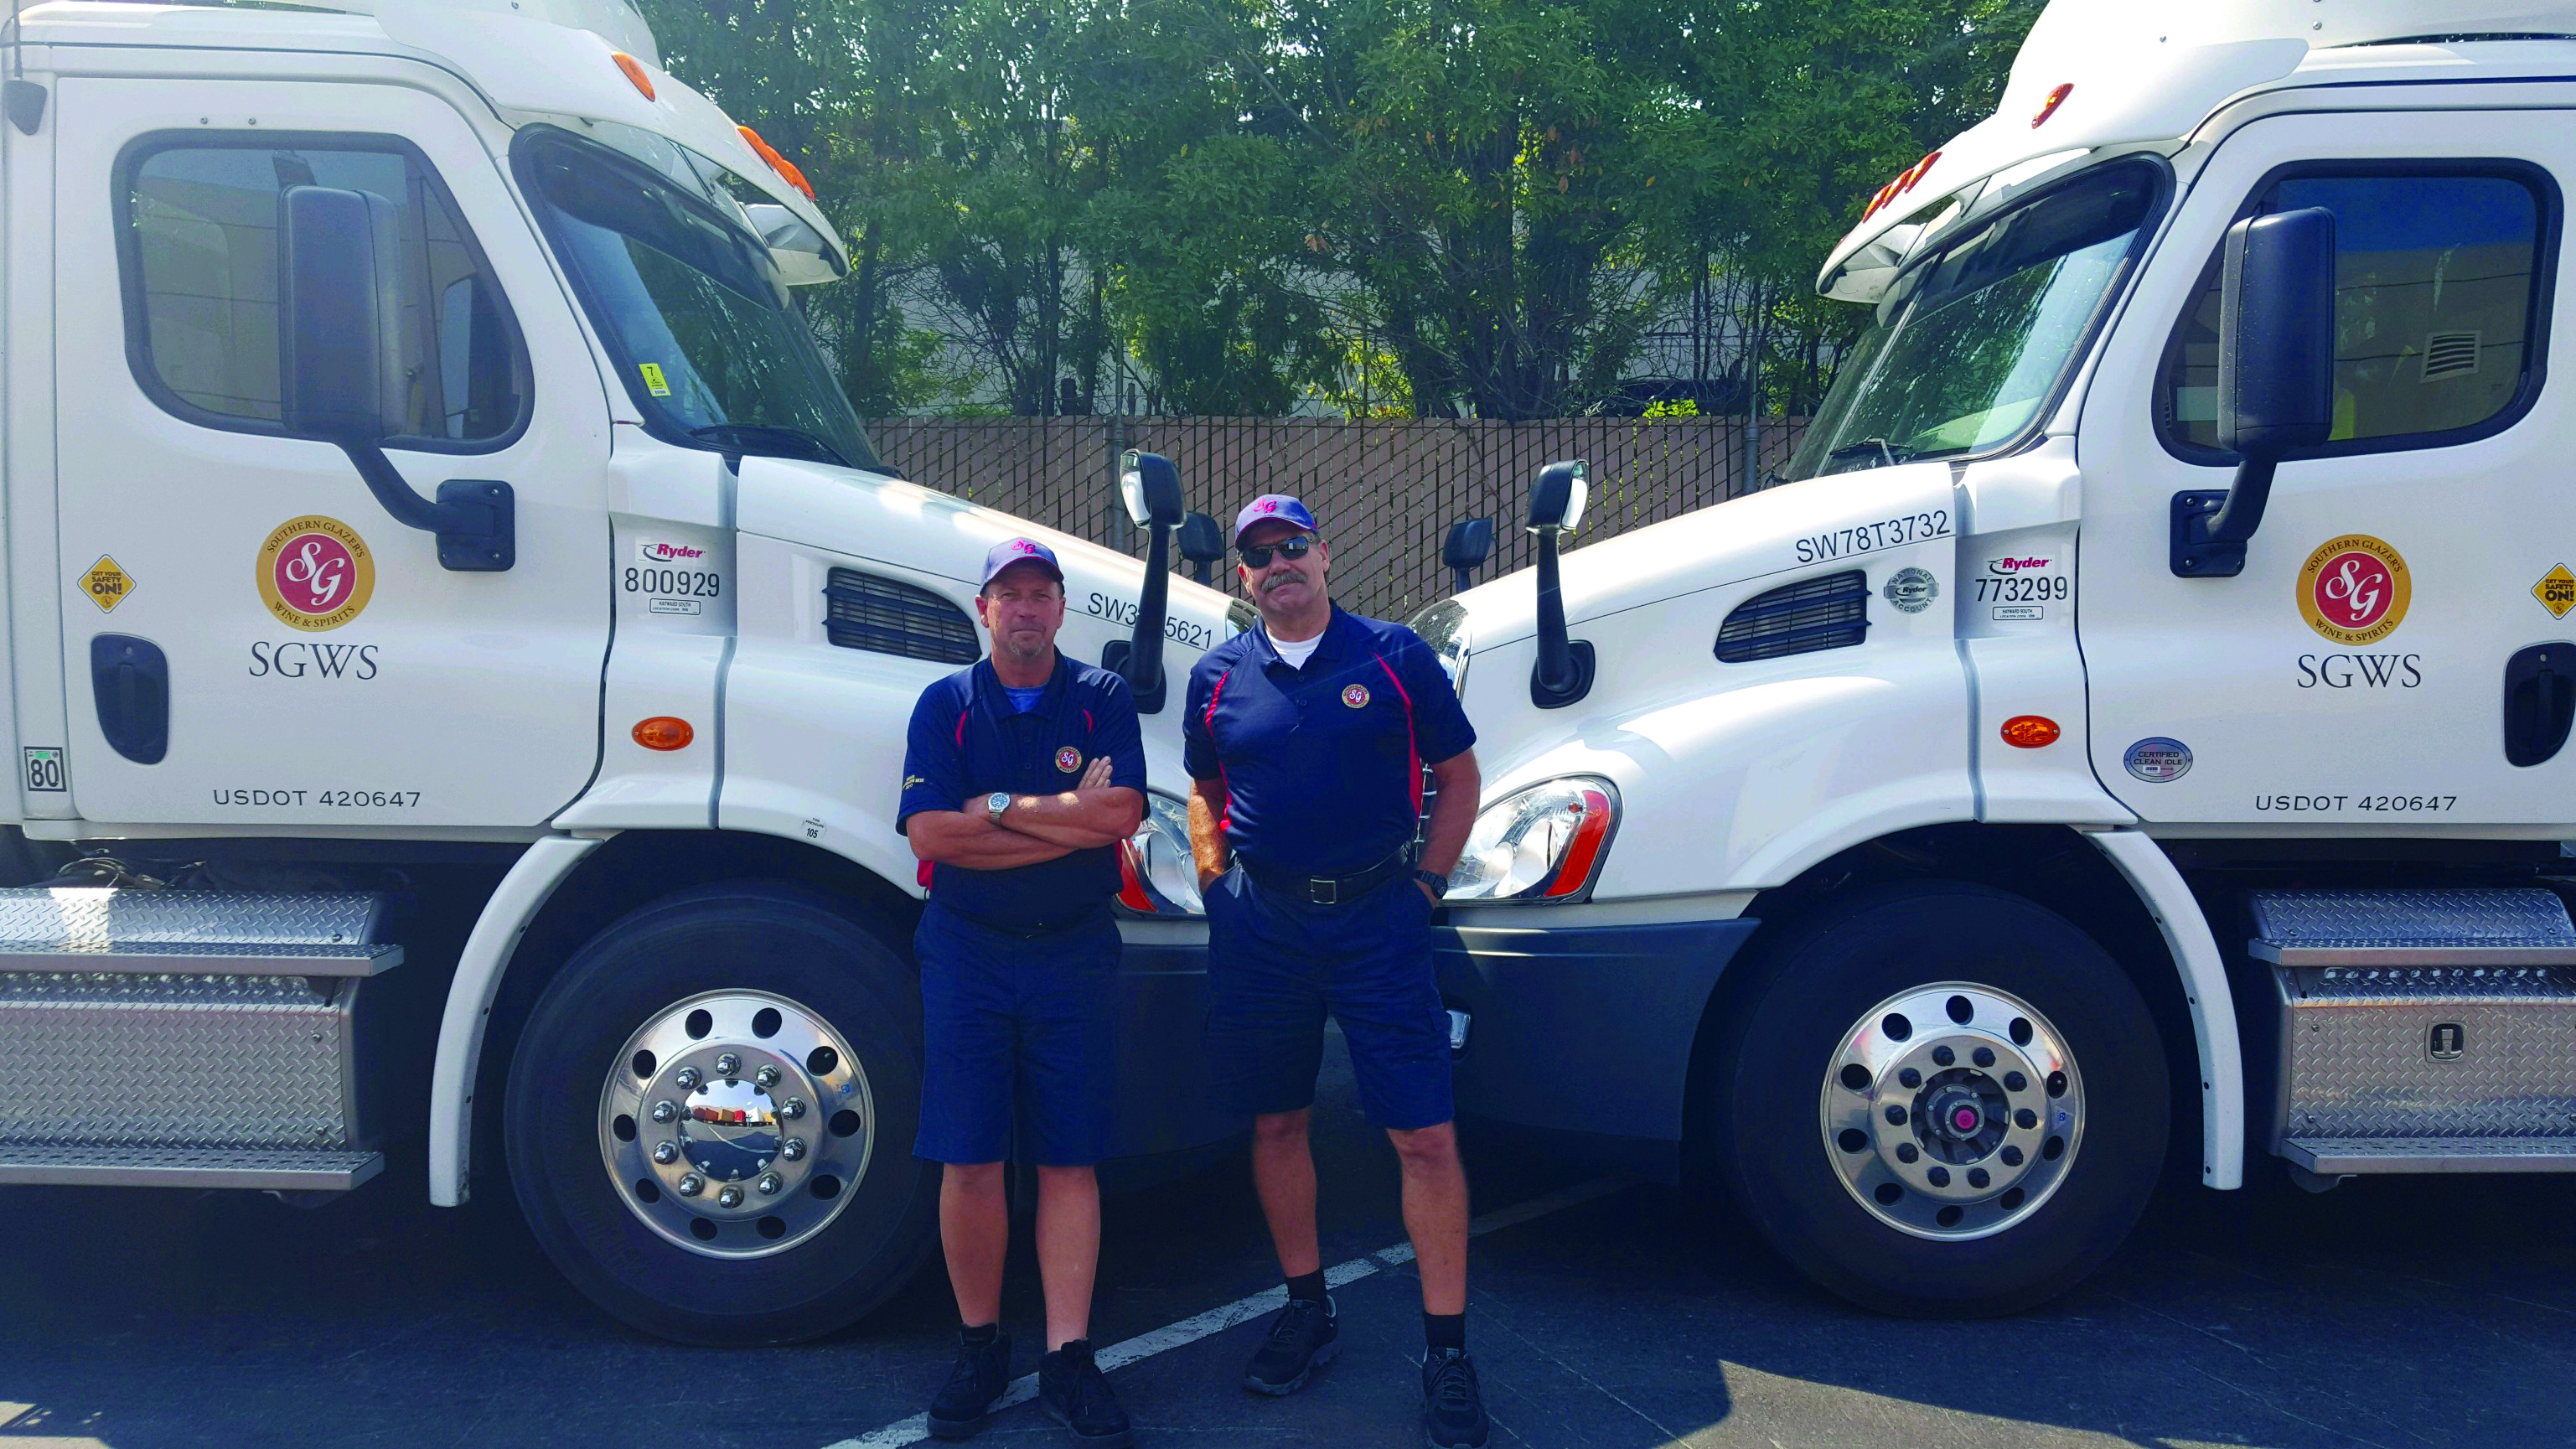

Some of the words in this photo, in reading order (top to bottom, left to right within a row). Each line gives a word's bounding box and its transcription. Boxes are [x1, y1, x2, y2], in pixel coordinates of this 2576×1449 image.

[266, 520, 321, 553] SOUTHERN
[323, 522, 365, 558] GLAZER'S
[1796, 510, 1950, 563] SW78T3732
[657, 543, 703, 558] Ryder
[2307, 539, 2360, 573] SOUTHERN
[2361, 540, 2403, 572] GLAZER'S
[286, 541, 345, 607] SG
[2002, 556, 2050, 571] Ryder
[624, 567, 720, 598] 800929
[1891, 568, 1932, 584] NATIONAL
[91, 582, 122, 595] ON!
[1975, 576, 2068, 602] 773299
[2325, 560, 2383, 621] SG
[2545, 590, 2574, 601] ON!
[274, 601, 303, 624] WINE
[313, 605, 355, 628] SPIRITS
[1893, 598, 1932, 612] ACCOUNT
[2315, 618, 2342, 639] WINE
[2356, 618, 2393, 641] SPIRITS
[249, 641, 379, 680] SGWS
[2297, 654, 2422, 688] SGWS
[1349, 690, 1362, 702] SG
[1061, 752, 1073, 766] SG
[31, 759, 59, 787] 80
[213, 789, 308, 806] USDOT
[319, 790, 421, 807] 420647
[2256, 795, 2348, 811] USDOT
[2357, 796, 2457, 811] 420647
[807, 828, 819, 838] 105
